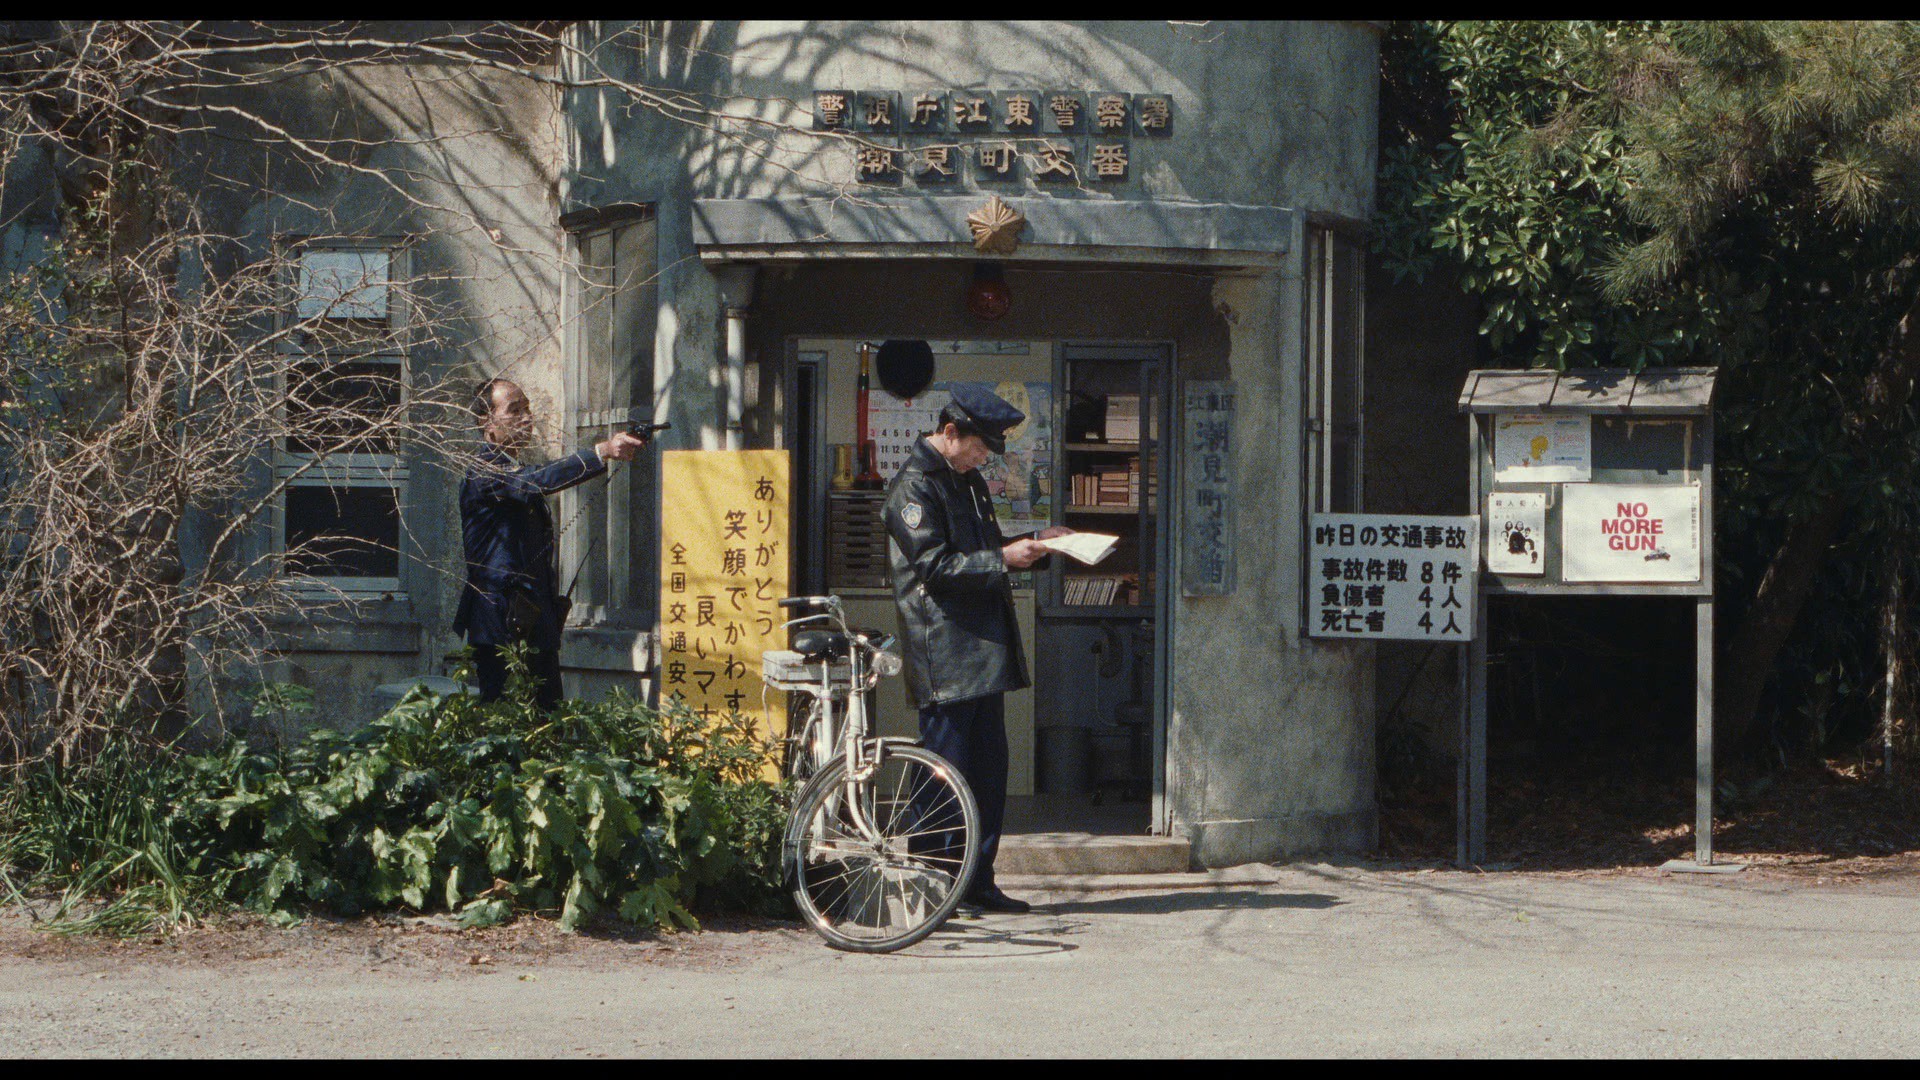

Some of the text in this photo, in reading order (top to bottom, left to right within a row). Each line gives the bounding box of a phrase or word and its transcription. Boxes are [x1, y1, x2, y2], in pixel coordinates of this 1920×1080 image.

[817, 93, 1170, 129] 警視庁江東警察署
[857, 142, 1128, 176] 潮見町交番
[881, 428, 887, 437] 4
[893, 429, 899, 437] 5
[905, 429, 911, 438] 6
[881, 445, 912, 454] 11 12 13
[880, 461, 900, 470] 18 19
[1616, 502, 1648, 518] NO
[1315, 523, 1466, 549] 昨日の交通事故
[1601, 518, 1663, 534] MORE
[1608, 535, 1656, 551] GUN
[755, 475, 780, 637] ありがとう
[1321, 557, 1408, 583] 事故件数
[1321, 583, 1386, 607] 負傷者
[721, 509, 748, 714] 笑顔でかわす
[1321, 609, 1386, 633] 死亡者
